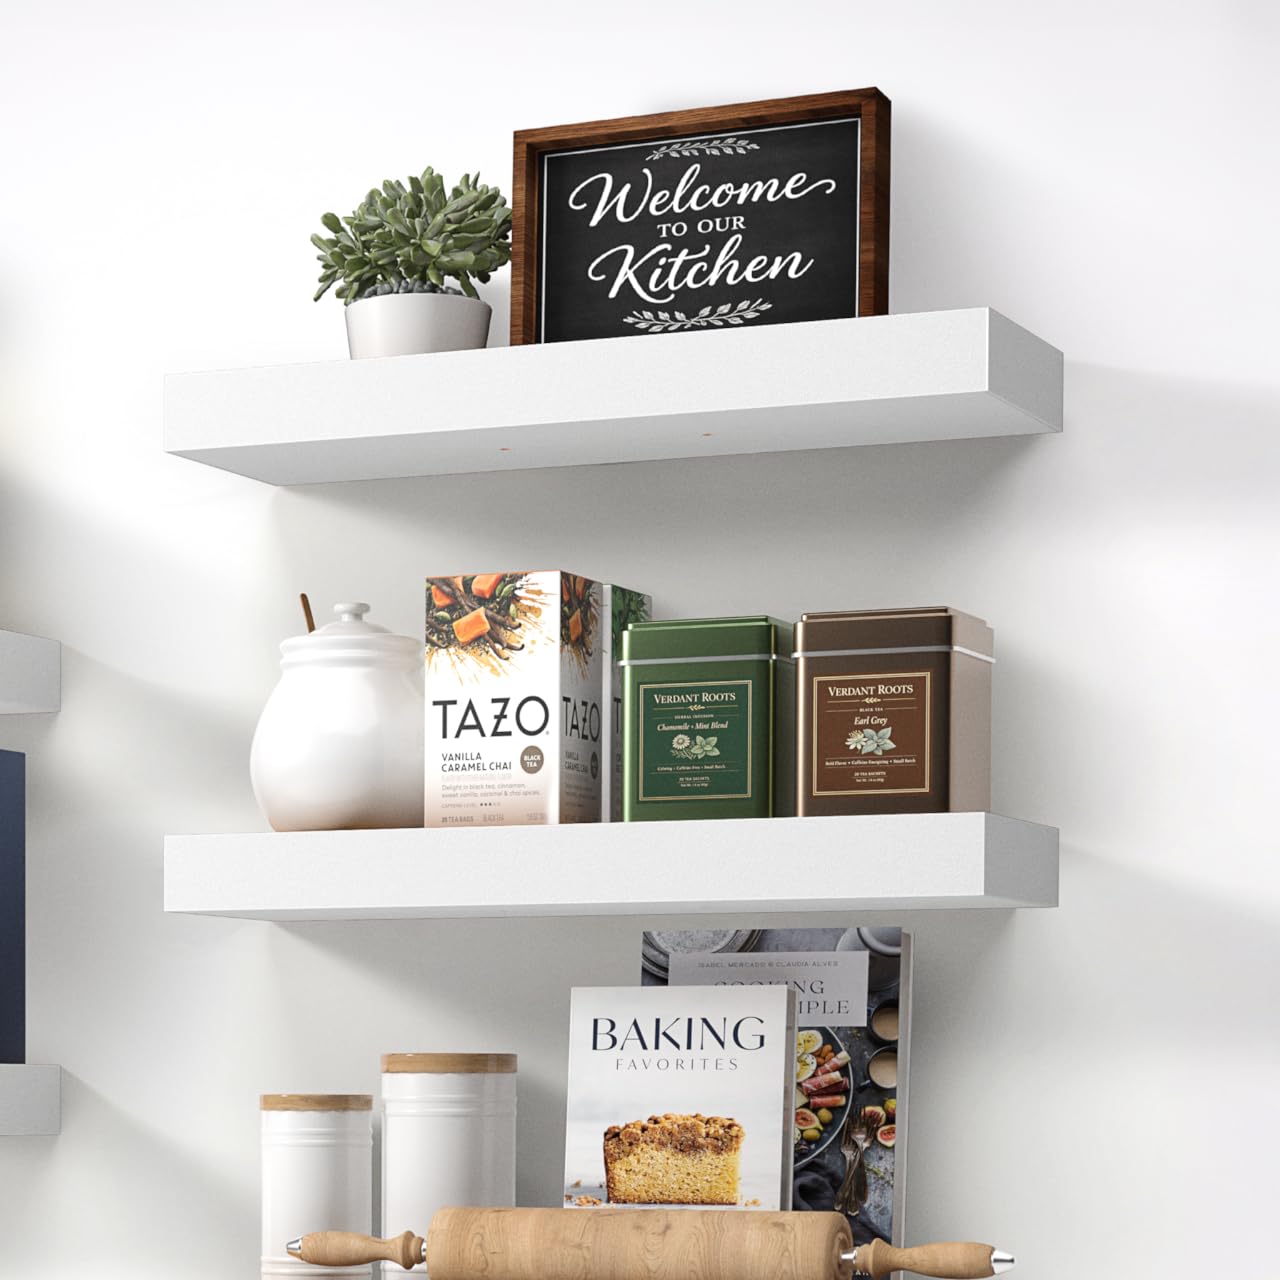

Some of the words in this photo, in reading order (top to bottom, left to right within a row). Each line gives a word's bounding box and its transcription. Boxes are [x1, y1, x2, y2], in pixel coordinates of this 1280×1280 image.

[568, 164, 836, 228] Welcome
[657, 222, 688, 238] TO
[697, 215, 746, 233] OUR
[588, 233, 814, 304] Kitchen
[828, 686, 875, 697] VERDANT
[878, 684, 914, 695] ROOTS
[654, 693, 699, 704] VERDANT
[702, 692, 736, 702] ROOTS
[432, 695, 550, 739] TAZO
[562, 696, 600, 742] TAZO
[854, 716, 870, 725] Earl
[870, 716, 888, 726] Grey
[694, 722, 710, 730] Mint
[710, 721, 729, 729] Blend
[441, 752, 482, 761] VANILLA
[523, 754, 541, 762] BLACK
[441, 763, 488, 773] CARAMEL
[489, 762, 512, 771] CHAI
[592, 1016, 765, 1051] BAKING
[616, 1058, 738, 1071] FAVORITES
